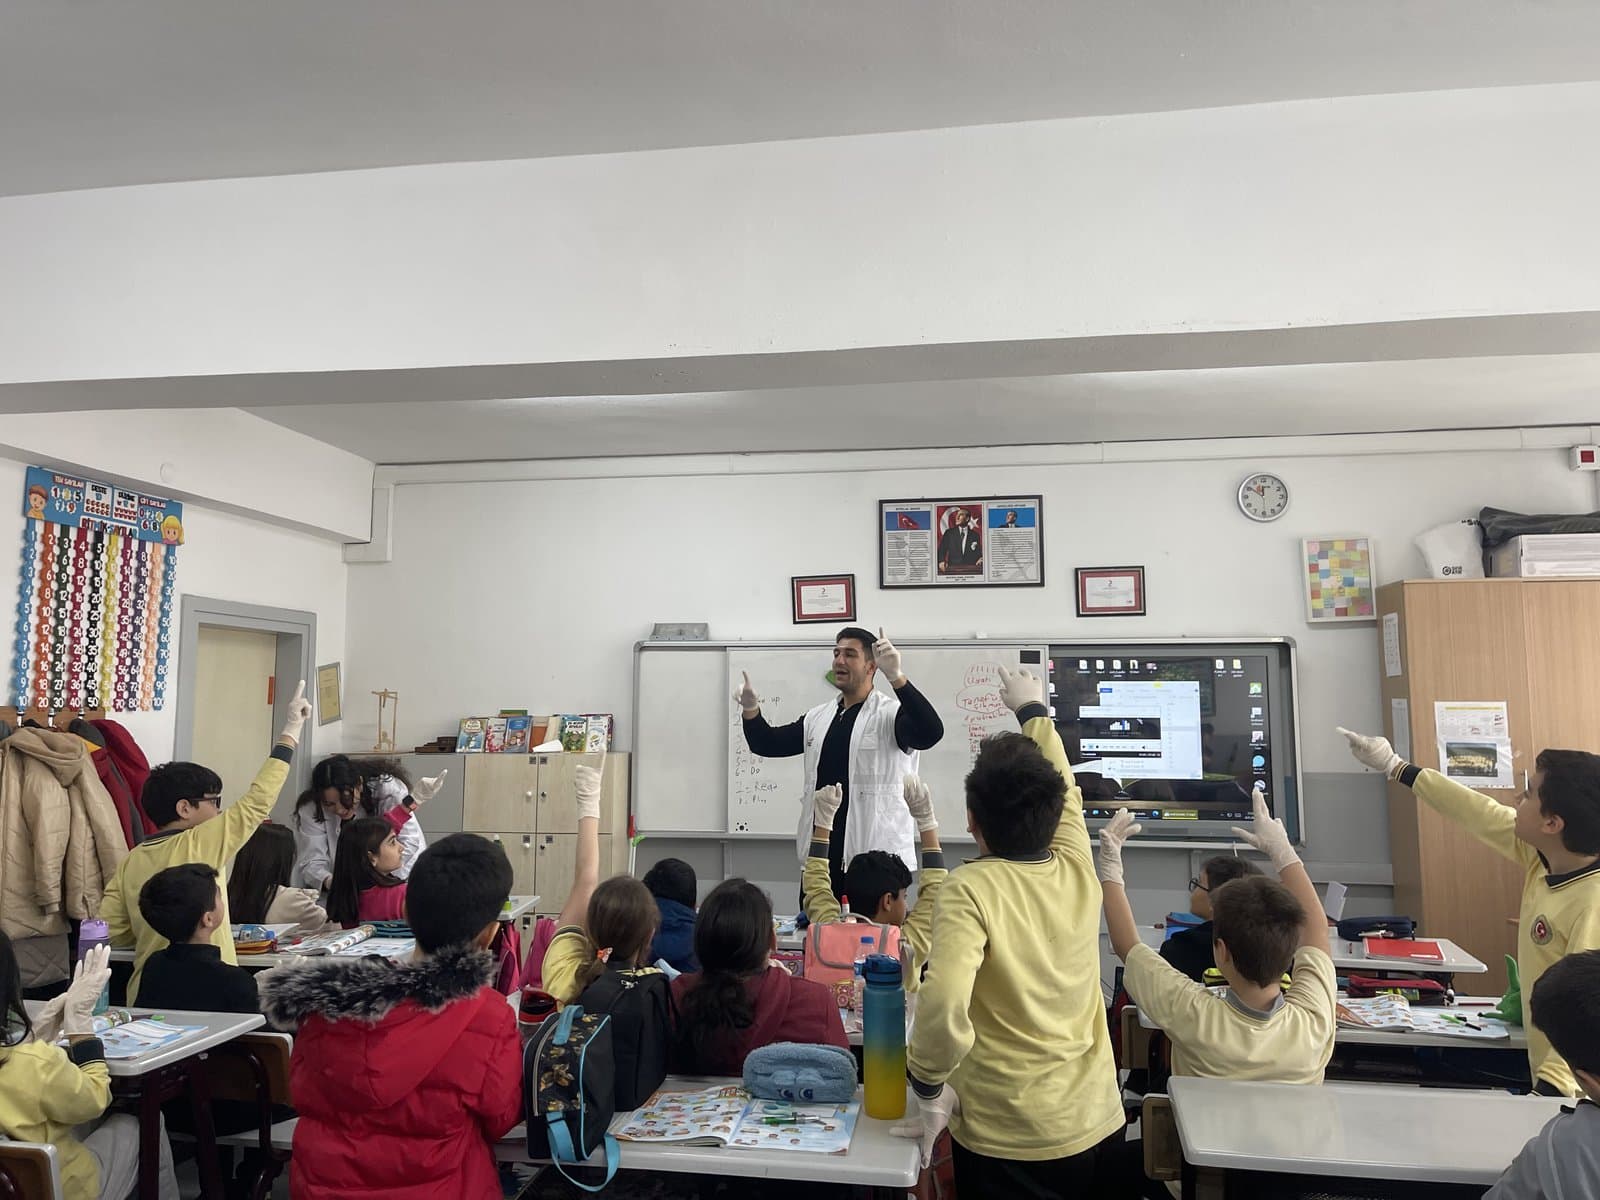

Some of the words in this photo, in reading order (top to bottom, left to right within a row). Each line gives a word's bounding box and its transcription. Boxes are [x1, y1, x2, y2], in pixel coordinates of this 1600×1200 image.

[53, 488, 58, 497] 1
[76, 492, 81, 501] 5
[69, 503, 74, 512] 9
[143, 520, 148, 529] 6
[32, 531, 34, 540] 1
[48, 535, 53, 544] 2
[64, 538, 68, 548] 3
[80, 541, 85, 551] 4
[97, 544, 102, 553] 5
[30, 549, 34, 558] 2
[48, 552, 52, 562] 4
[127, 550, 130, 559] 7
[142, 552, 146, 561] 8
[63, 555, 67, 565] 6
[78, 558, 84, 568] 8
[169, 556, 176, 565] 10
[94, 560, 101, 570] 10
[28, 568, 33, 577] 3
[47, 570, 51, 580] 6
[124, 566, 130, 575] 14
[141, 568, 147, 576] 16
[62, 573, 66, 583] 9
[168, 571, 176, 580] 20
[77, 576, 84, 585] 12
[94, 577, 101, 587] 15
[26, 586, 31, 595] 4
[123, 582, 130, 591] 21
[139, 584, 146, 593] 24
[166, 587, 175, 595] 30
[45, 588, 50, 599] 8
[60, 591, 67, 600] 12
[75, 593, 82, 602] 16
[92, 593, 100, 603] 20
[24, 603, 29, 613] 5
[122, 599, 130, 608] 28
[137, 600, 144, 609] 32
[164, 602, 172, 611] 40
[42, 607, 50, 617] 10
[58, 608, 66, 618] 15
[73, 610, 82, 620] 20
[91, 611, 99, 620] 25
[121, 616, 129, 625] 35
[134, 616, 143, 625] 40
[163, 618, 170, 627] 50
[23, 622, 28, 632] 6
[42, 625, 49, 634] 12
[58, 626, 65, 636] 18
[73, 627, 81, 637] 24
[89, 628, 98, 637] 30
[120, 632, 128, 641] 42
[133, 632, 142, 641] 48
[161, 633, 170, 642] 60
[23, 640, 27, 650] 7
[41, 643, 49, 653] 14
[56, 644, 64, 654] 21
[88, 645, 97, 655] 35
[132, 649, 142, 657] 56
[160, 649, 169, 658] 70
[21, 658, 27, 669] 8
[40, 661, 48, 671] 16
[55, 662, 64, 672] 24
[72, 662, 81, 672] 32
[87, 663, 96, 672] 40
[118, 666, 127, 675] 56
[131, 665, 140, 674] 64
[158, 665, 168, 674] 80
[21, 678, 26, 688] 9
[39, 679, 47, 689] 18
[71, 680, 80, 689] 36
[87, 680, 96, 689] 45
[117, 682, 126, 691] 63
[130, 682, 138, 691] 72
[156, 681, 166, 690] 90
[18, 696, 27, 706] 10
[38, 697, 48, 707] 20
[53, 697, 64, 707] 30
[70, 697, 80, 707] 40
[87, 697, 98, 707] 50
[115, 699, 124, 709] 70
[128, 699, 137, 708] 80
[154, 698, 163, 706] 100
